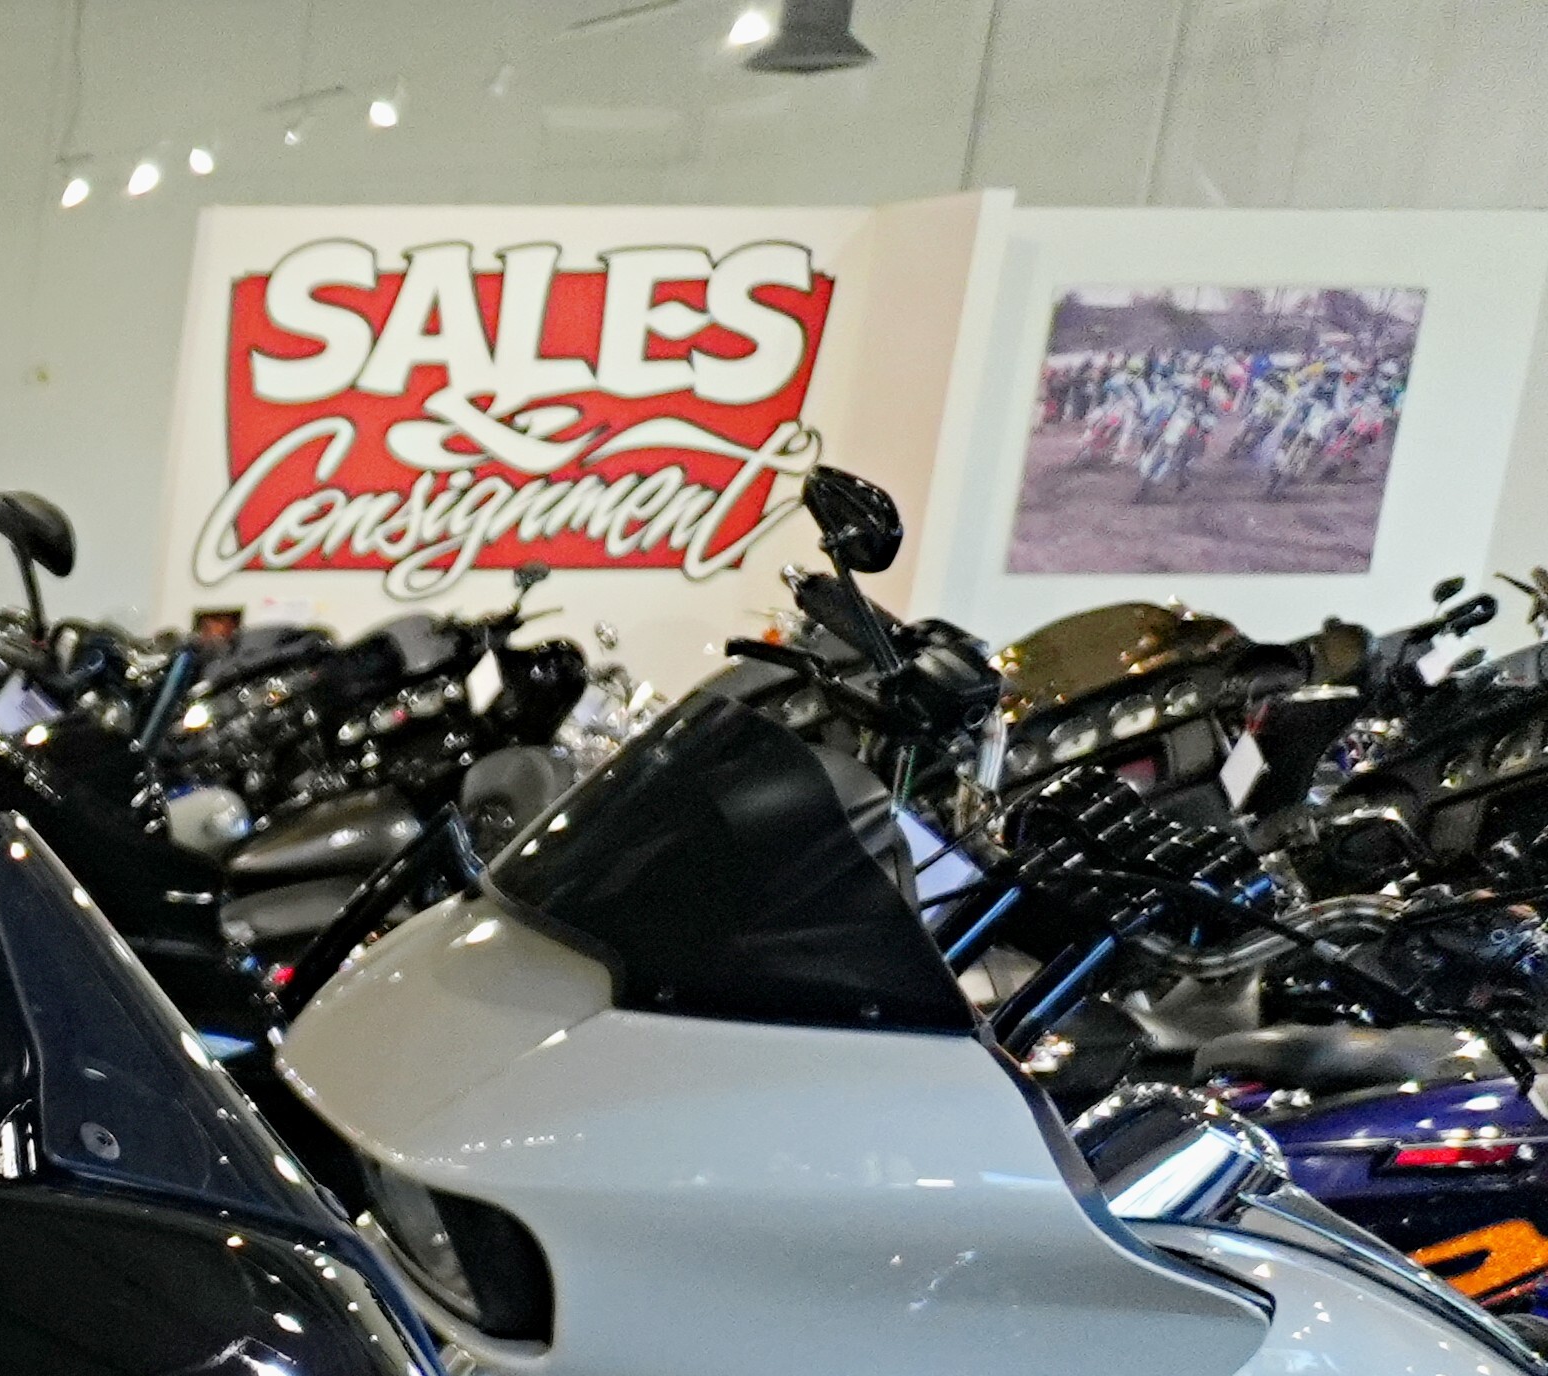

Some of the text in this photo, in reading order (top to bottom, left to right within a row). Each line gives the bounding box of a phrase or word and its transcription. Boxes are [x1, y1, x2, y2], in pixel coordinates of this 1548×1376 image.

[251, 237, 822, 404] SALES
[193, 414, 823, 601] Consignment
[385, 391, 608, 475] &
